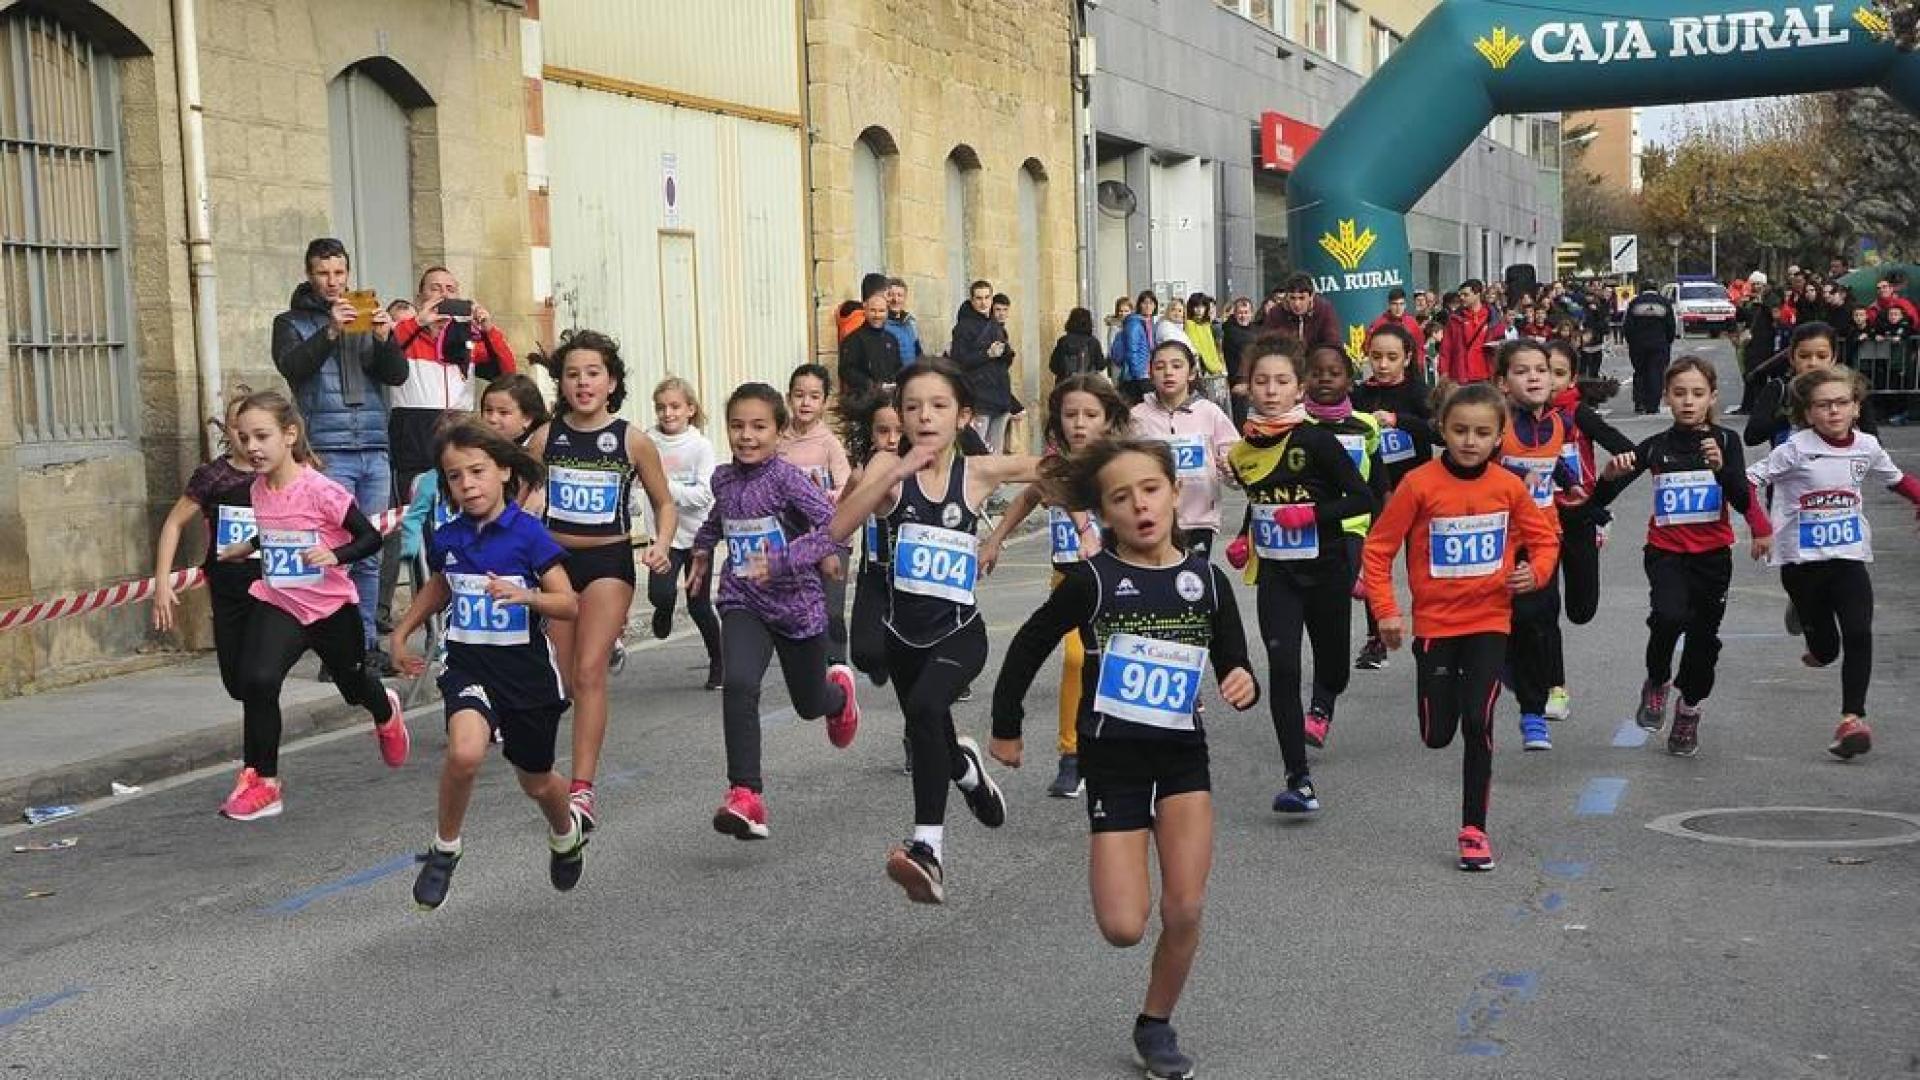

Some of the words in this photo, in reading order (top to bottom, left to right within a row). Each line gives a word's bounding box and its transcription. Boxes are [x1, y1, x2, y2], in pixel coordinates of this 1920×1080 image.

[1531, 20, 1656, 64] CAJA
[1669, 4, 1849, 57] RURAL
[1344, 268, 1403, 289] RURAL
[1171, 447, 1194, 466] 12
[1288, 448, 1306, 471] G
[560, 485, 605, 511] 905
[1663, 487, 1709, 512] 917
[229, 522, 258, 544] 92
[1812, 520, 1854, 545] 906
[263, 547, 304, 574] 921
[1444, 533, 1496, 563] 918
[911, 546, 967, 585] 904
[456, 596, 511, 629] 915
[1120, 662, 1188, 709] 903
